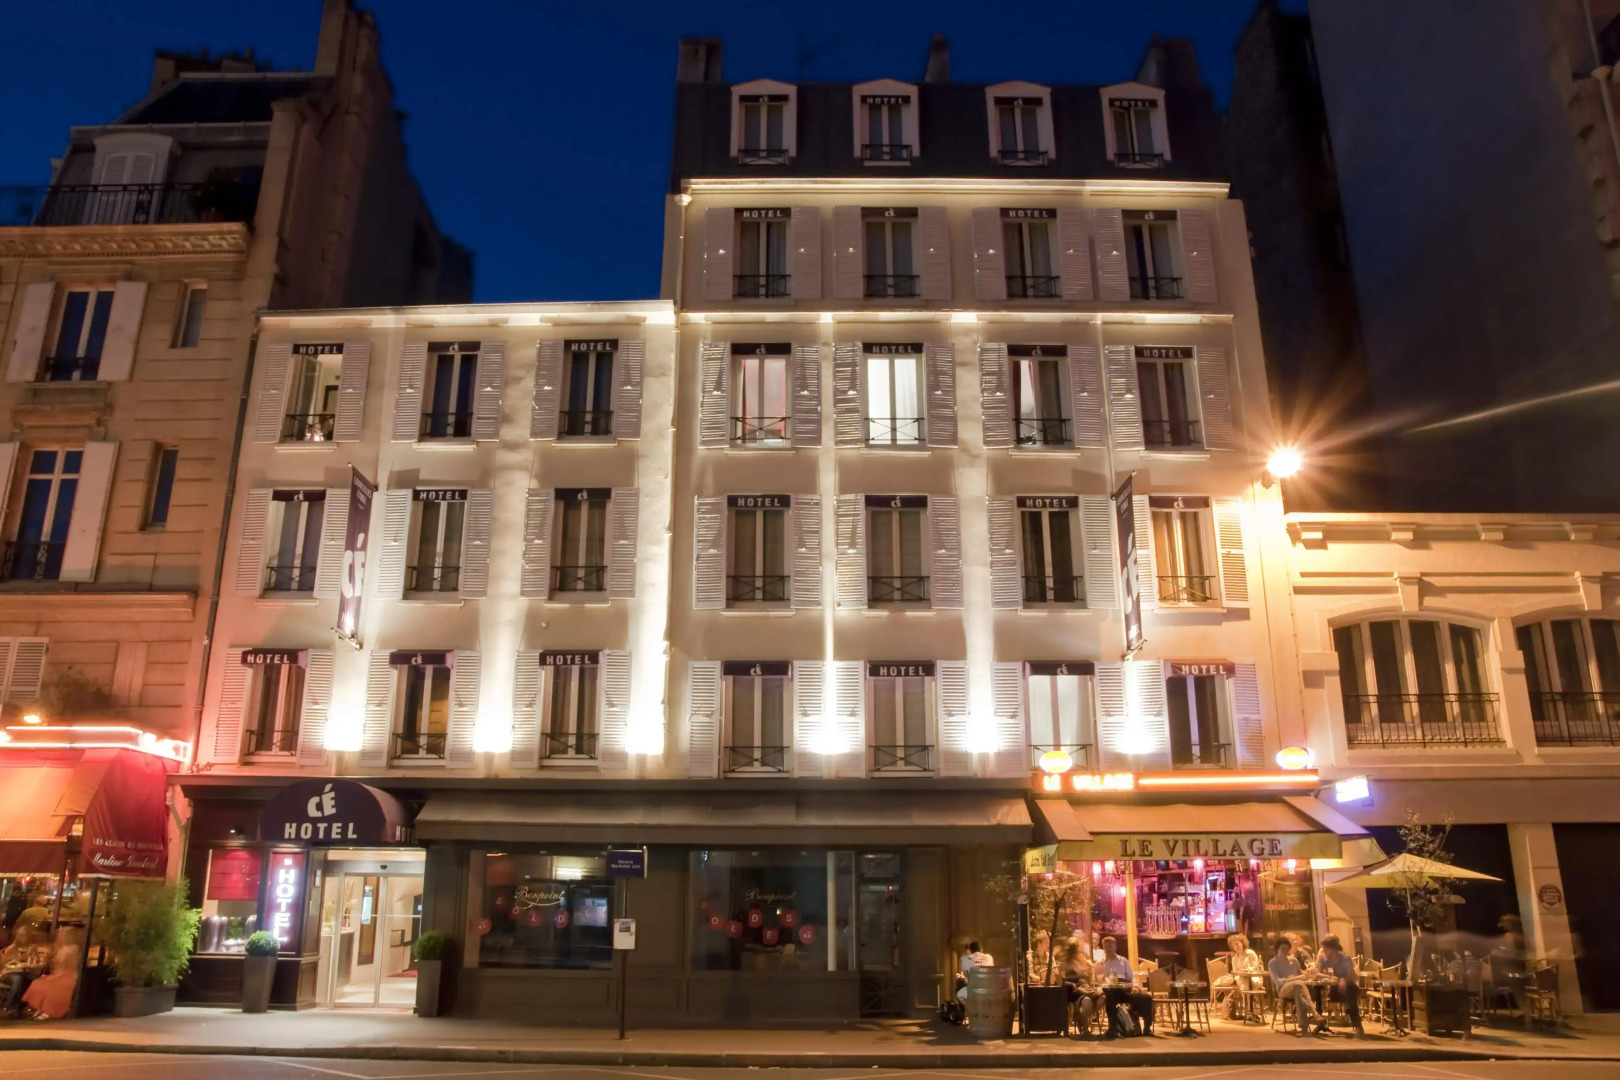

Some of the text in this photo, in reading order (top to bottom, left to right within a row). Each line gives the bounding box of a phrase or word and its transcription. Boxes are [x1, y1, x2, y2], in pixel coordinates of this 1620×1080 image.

[743, 210, 782, 218] HOTEL
[1009, 210, 1048, 218] HOTEL
[300, 346, 338, 354] HOTEL
[571, 343, 613, 351] HOTEL
[873, 346, 913, 354] HOTEL
[1143, 349, 1184, 358] HOTEL
[420, 491, 461, 500] HOTEL
[738, 498, 780, 507] HOTEL
[1027, 499, 1069, 508] HOTEL
[247, 654, 291, 664] HOTEL
[411, 653, 422, 665] CÉ
[547, 655, 591, 664] HOTEL
[750, 664, 762, 676] CÉ
[880, 666, 925, 676] HOTEL
[1057, 664, 1068, 675] CÉ
[1181, 665, 1226, 675] HOTEL
[1043, 772, 1135, 791] LE VILLAGE
[307, 783, 337, 818] CÉ
[284, 822, 358, 839] HOTEL
[1119, 837, 1283, 857] LE VILLAGE
[514, 885, 566, 904] Bonpoint
[273, 868, 296, 942] HOTEL
